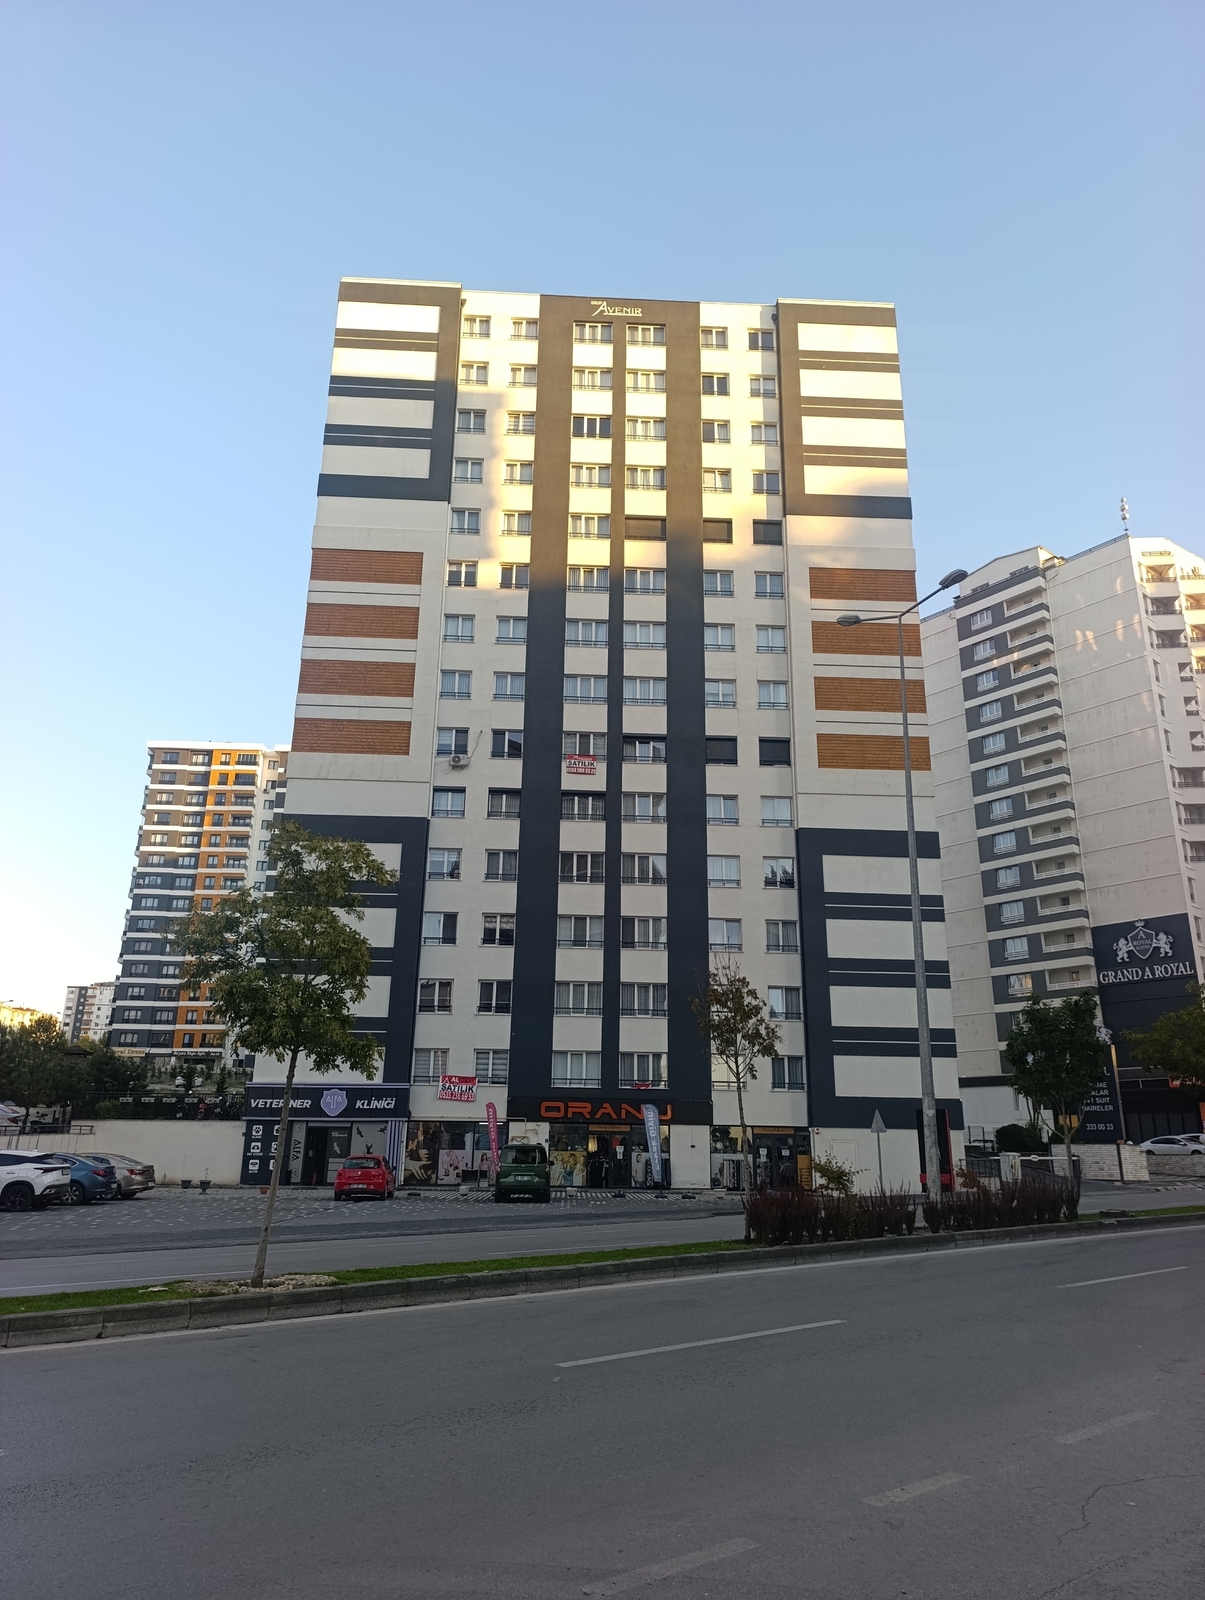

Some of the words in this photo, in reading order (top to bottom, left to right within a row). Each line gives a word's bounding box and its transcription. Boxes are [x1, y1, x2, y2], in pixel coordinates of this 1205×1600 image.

[1137, 930, 1146, 939] A
[1100, 968, 1142, 984] GRAND
[1144, 966, 1153, 979] A
[1153, 961, 1194, 978] ROYAL
[441, 1083, 474, 1093] SATILIK
[250, 1098, 312, 1108] VETERNER
[325, 1095, 343, 1109] ALFA
[355, 1097, 396, 1109] KLİNİĞİ
[1098, 1123, 1105, 1131] 00
[292, 1139, 301, 1161] ALFA
